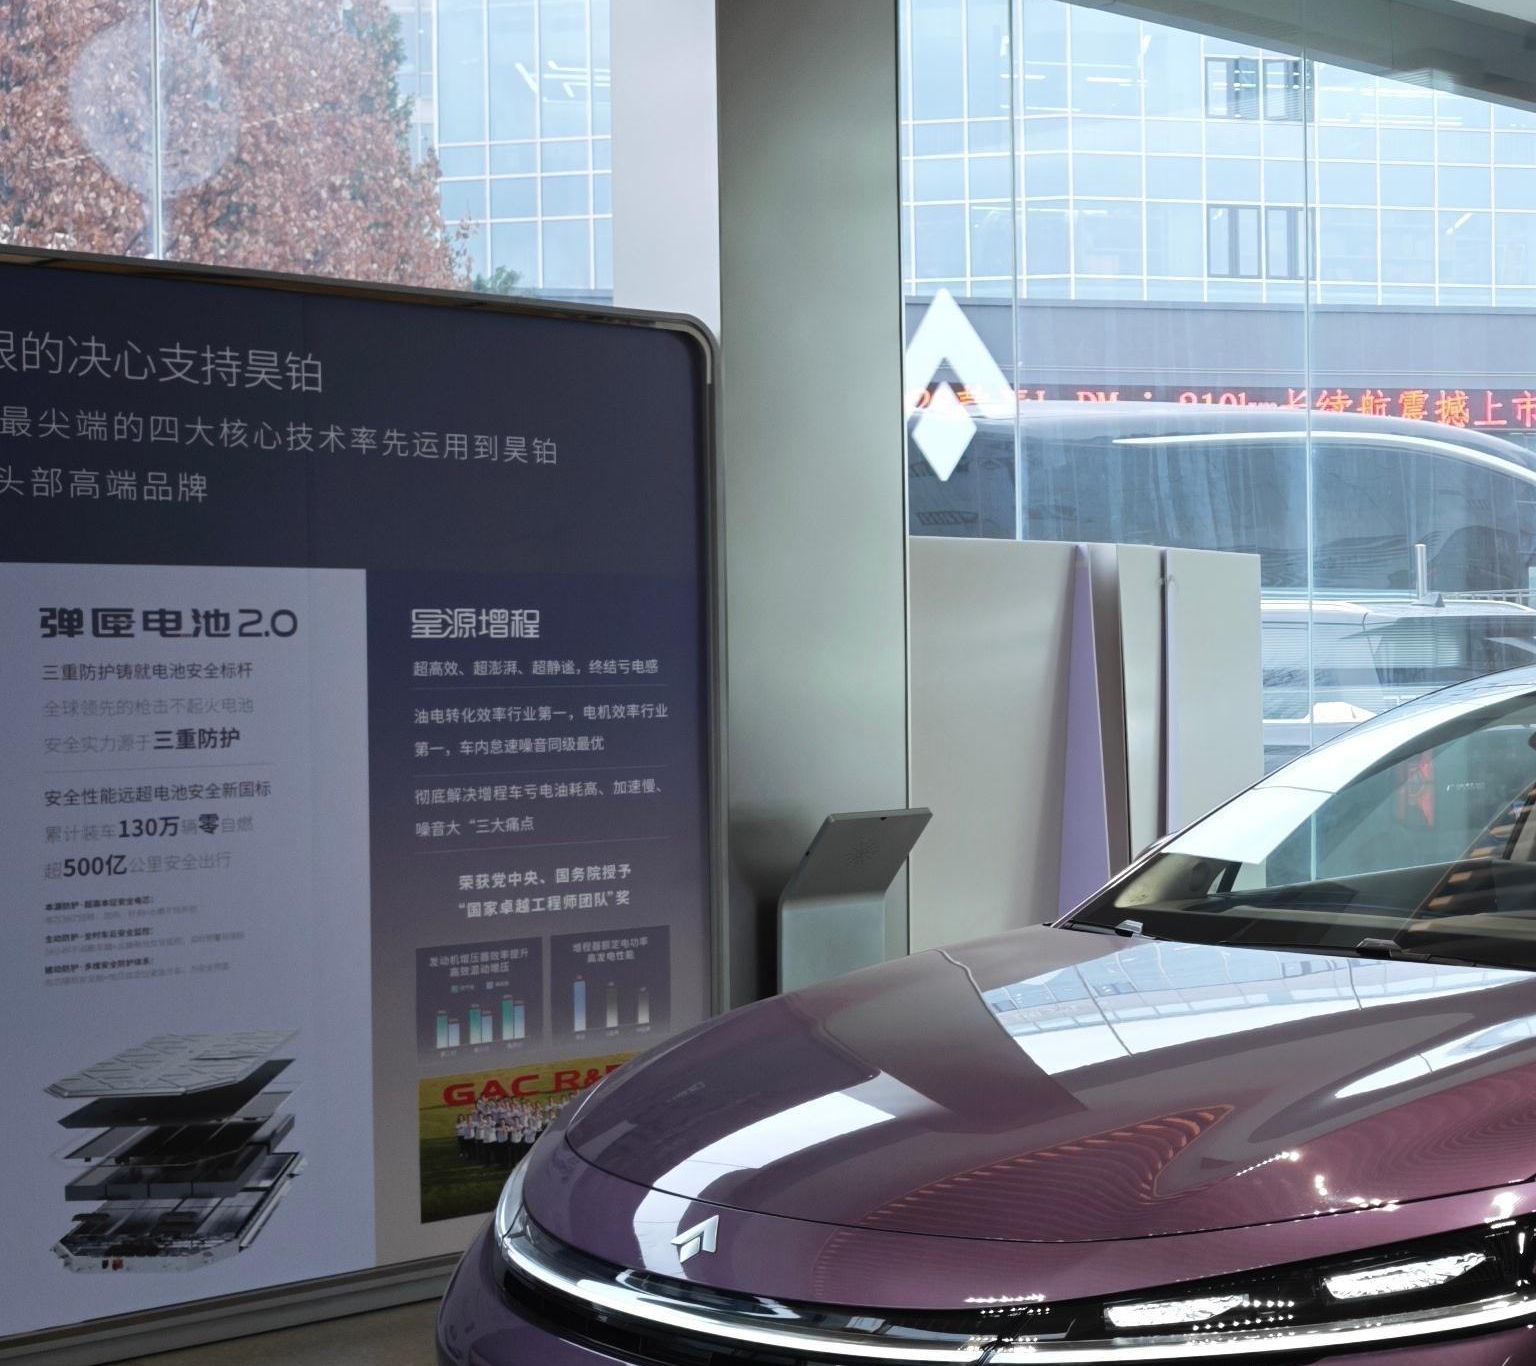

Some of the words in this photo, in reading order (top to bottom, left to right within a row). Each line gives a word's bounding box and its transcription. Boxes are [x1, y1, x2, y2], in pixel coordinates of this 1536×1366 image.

[0, 405, 558, 466] 最尖端的四大核心技术率先运用到昊铂
[0, 465, 208, 503] 头部高端品牌
[39, 607, 298, 638] 弹匣电池2.0
[411, 608, 540, 638] 星源增程
[41, 662, 254, 681] 三重防护铸就电池安全标杆
[44, 781, 272, 807] 安全性能远超电池安全新国标
[443, 1074, 543, 1107] GAC
